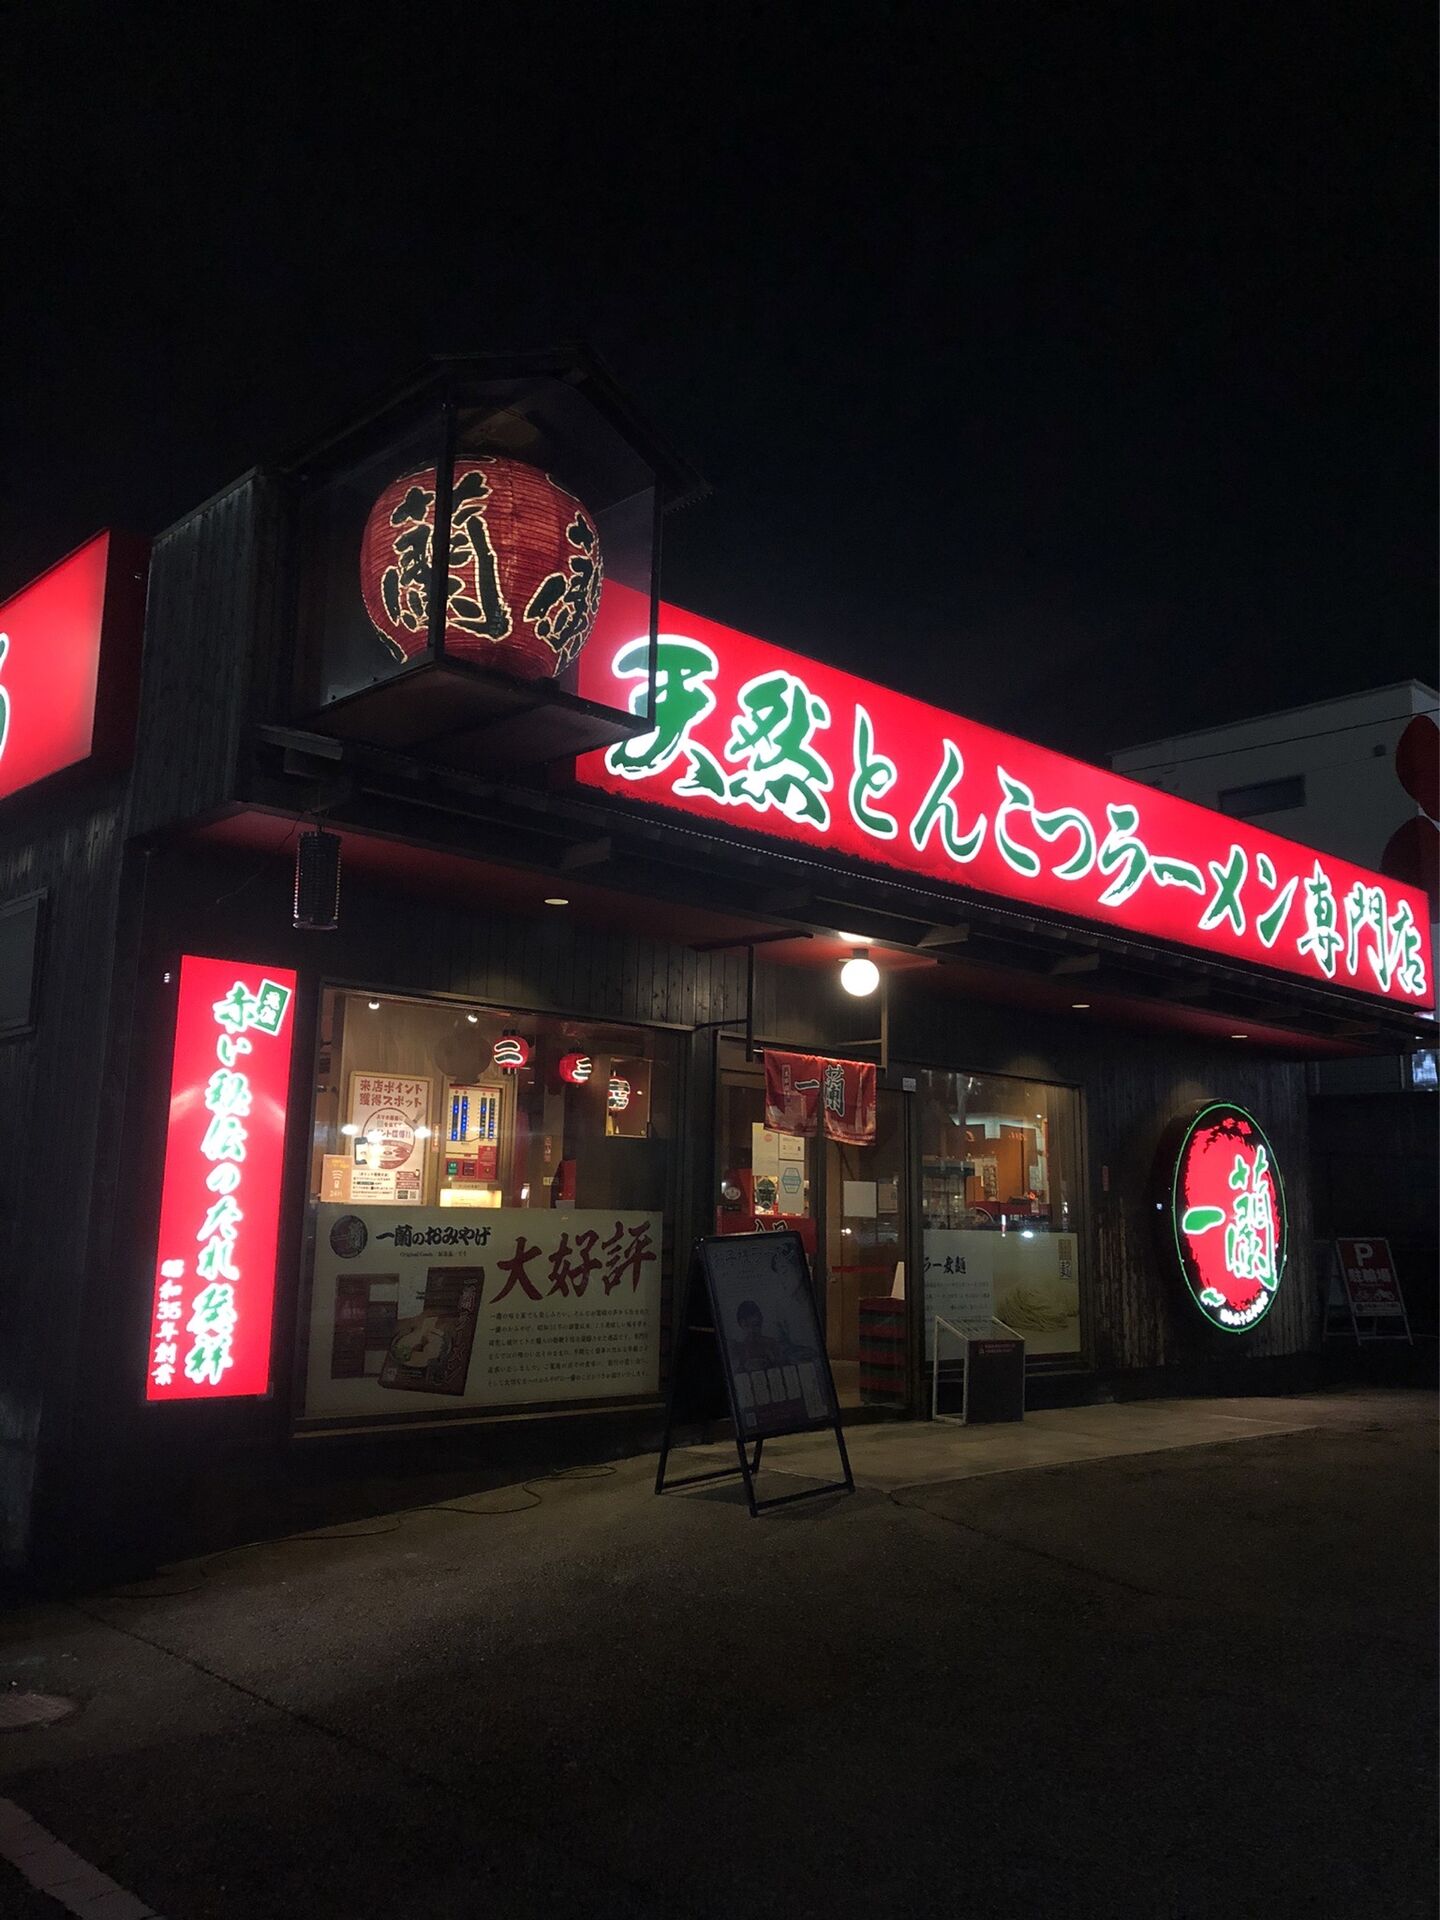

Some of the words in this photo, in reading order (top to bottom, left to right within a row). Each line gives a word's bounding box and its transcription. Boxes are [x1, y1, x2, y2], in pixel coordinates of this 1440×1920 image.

[605, 634, 1426, 996] 天然とんこつラーメン専門店
[360, 1079, 423, 1095] 来店ポイント
[794, 1063, 846, 1117] 一蘭
[376, 1224, 491, 1248] 一蘭のおみやげ
[1182, 1145, 1277, 1291] 一蘭
[489, 1221, 658, 1304] 大好評
[1353, 1243, 1374, 1267] P
